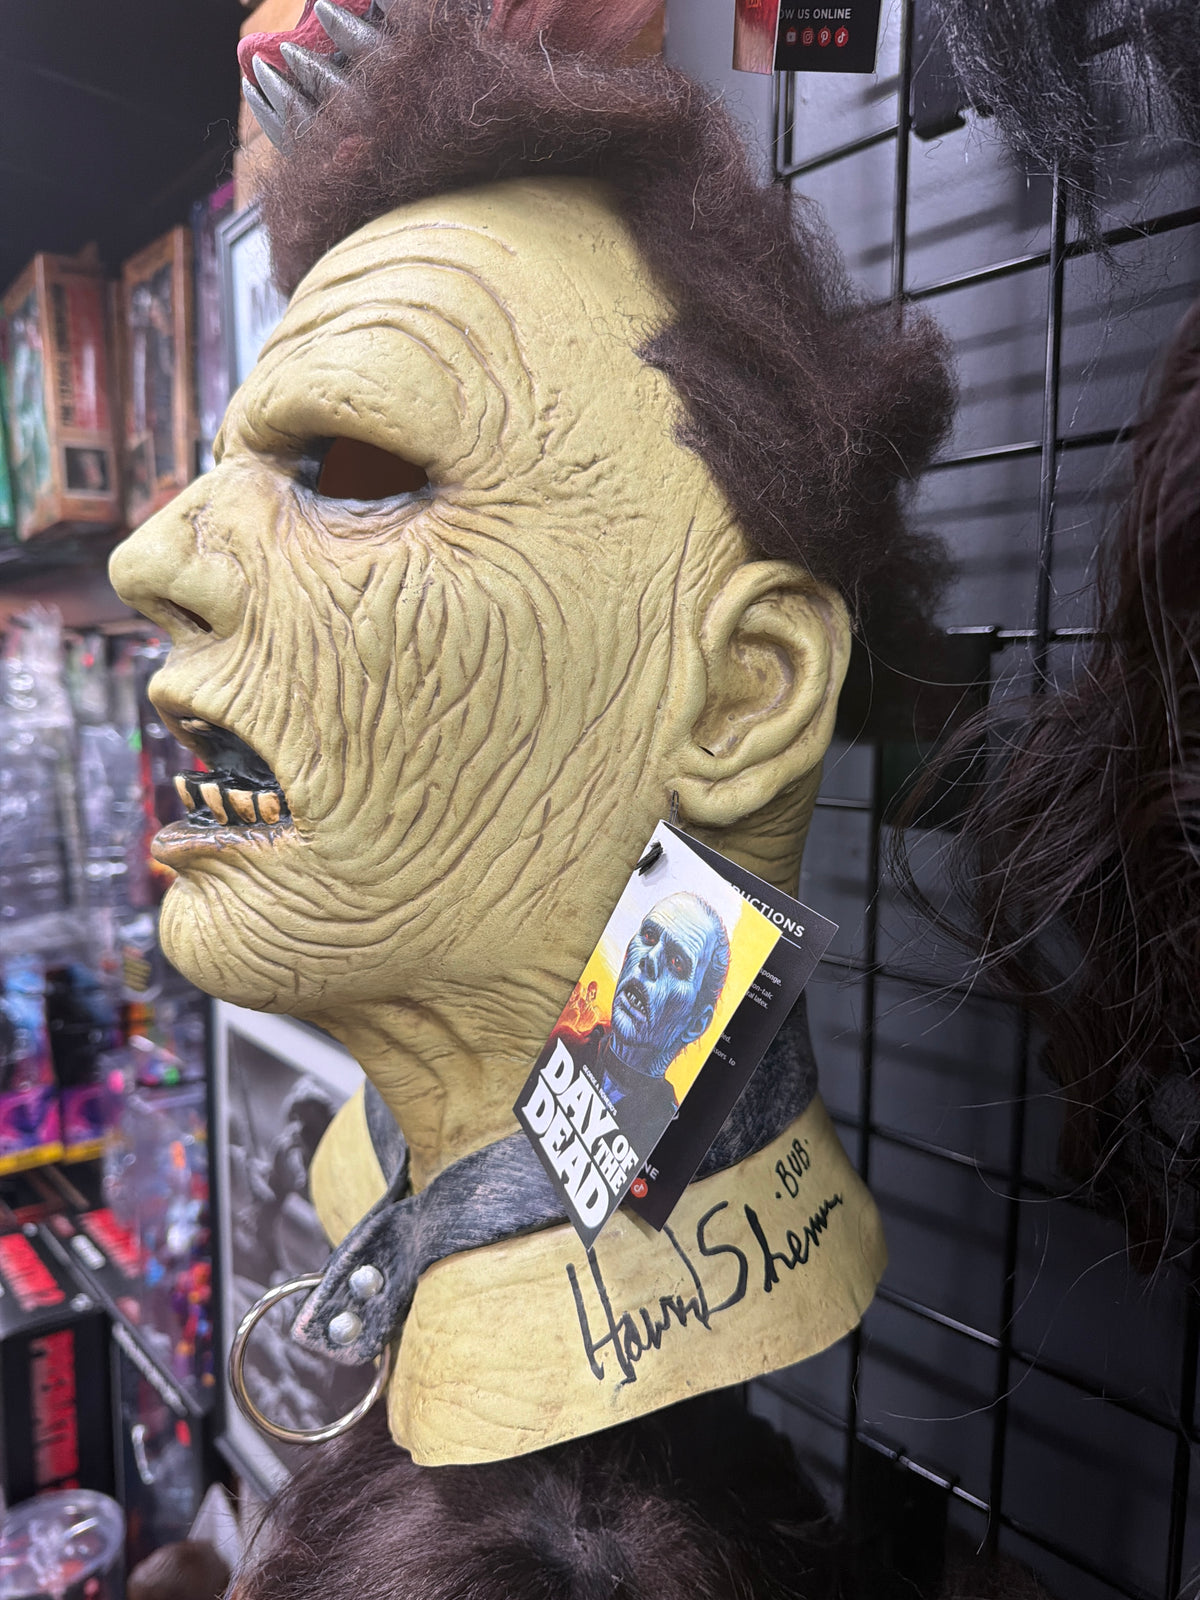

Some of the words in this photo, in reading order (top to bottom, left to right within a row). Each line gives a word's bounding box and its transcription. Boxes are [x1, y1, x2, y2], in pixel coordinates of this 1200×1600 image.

[797, 8, 810, 20] US
[813, 8, 852, 20] ONLINE
[728, 1057, 736, 1066] to
[540, 1037, 619, 1148] DAY
[521, 1074, 609, 1229] DEAD
[593, 1137, 628, 1197] THE
[611, 1134, 640, 1173] OF
